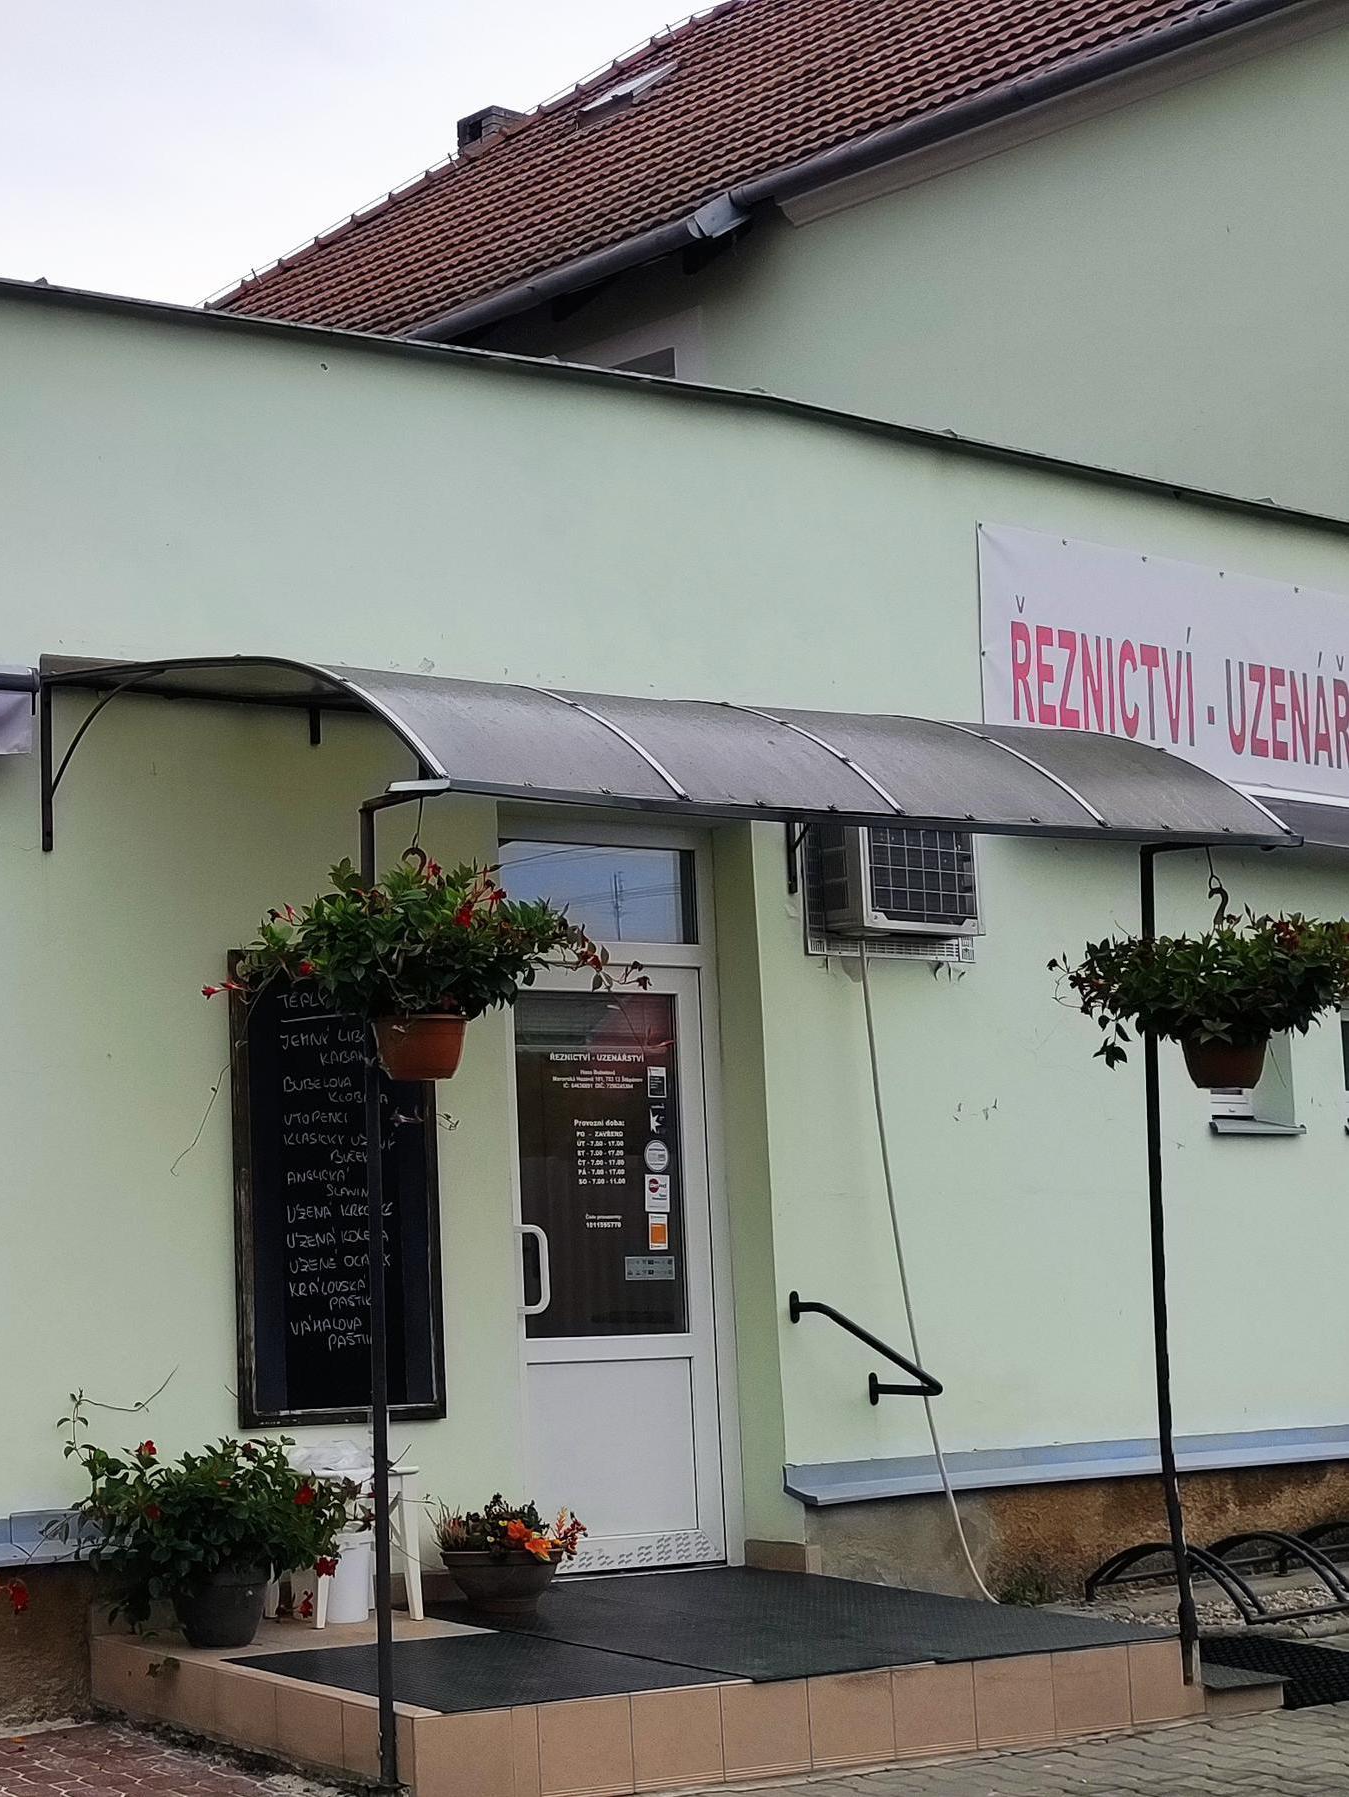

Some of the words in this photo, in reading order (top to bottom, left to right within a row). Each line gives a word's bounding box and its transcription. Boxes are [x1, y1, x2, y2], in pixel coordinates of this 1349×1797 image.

[1010, 594, 1196, 748] ŘEZNICTVÍ
[325, 1184, 370, 1198] SLANIN
[341, 1228, 389, 1243] KOLEA
[329, 1295, 373, 1312] PAŠTIK
